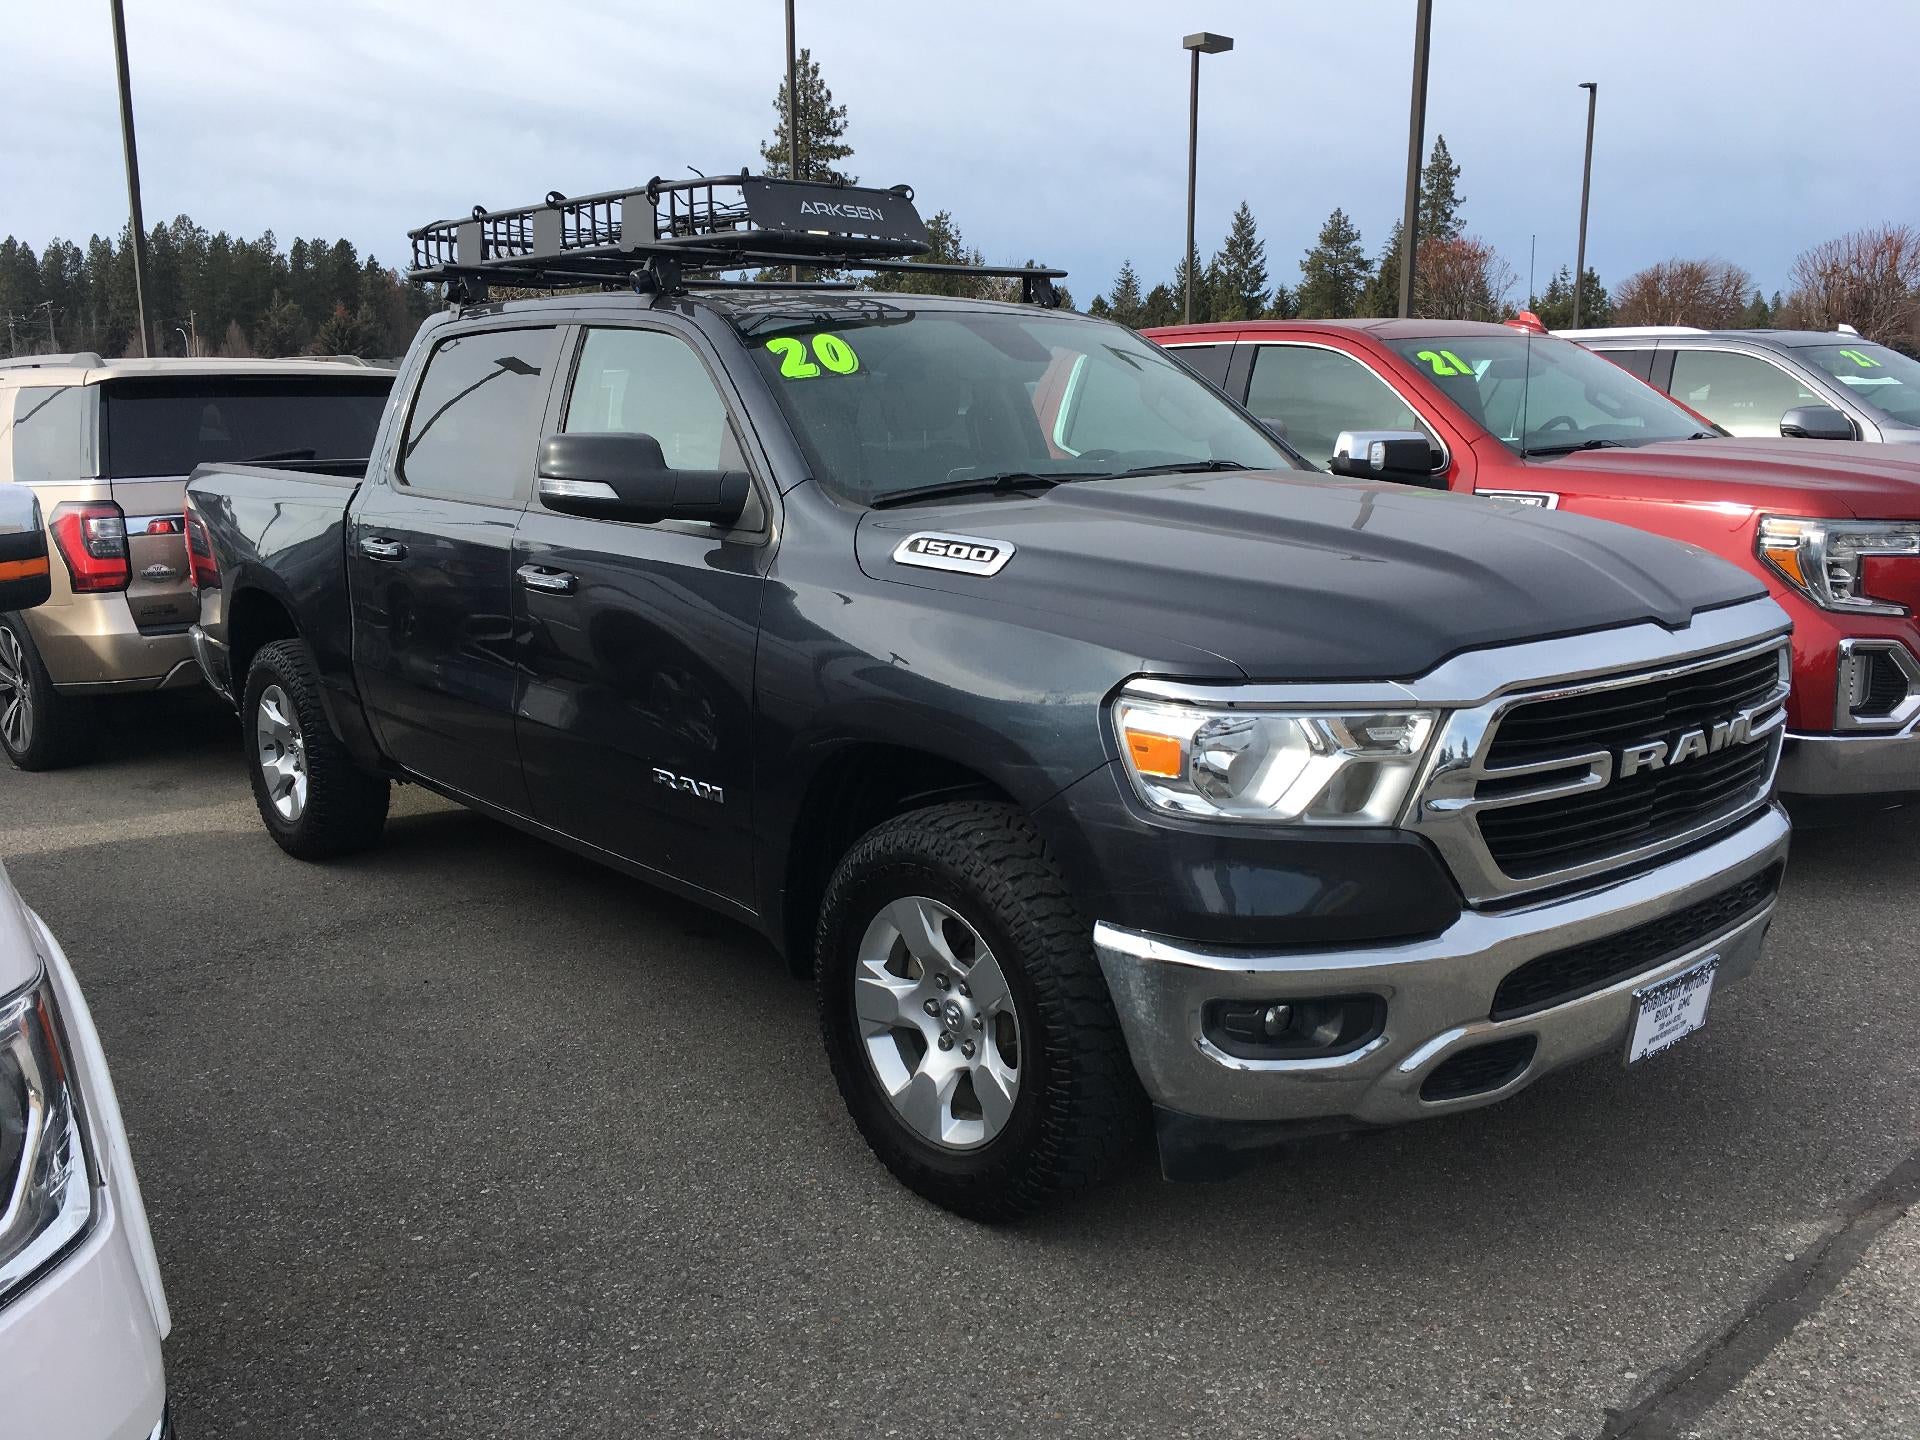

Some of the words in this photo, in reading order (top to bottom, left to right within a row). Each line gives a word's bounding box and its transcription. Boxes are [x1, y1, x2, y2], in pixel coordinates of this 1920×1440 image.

[800, 200, 884, 221] ARKSEN
[765, 333, 860, 379] 20
[1416, 350, 1475, 376] 21
[1839, 350, 1882, 368] 21
[916, 539, 995, 561] 1500
[1619, 715, 1747, 779] RAM
[651, 767, 724, 804] RAM
[1677, 993, 1693, 1011] GMC
